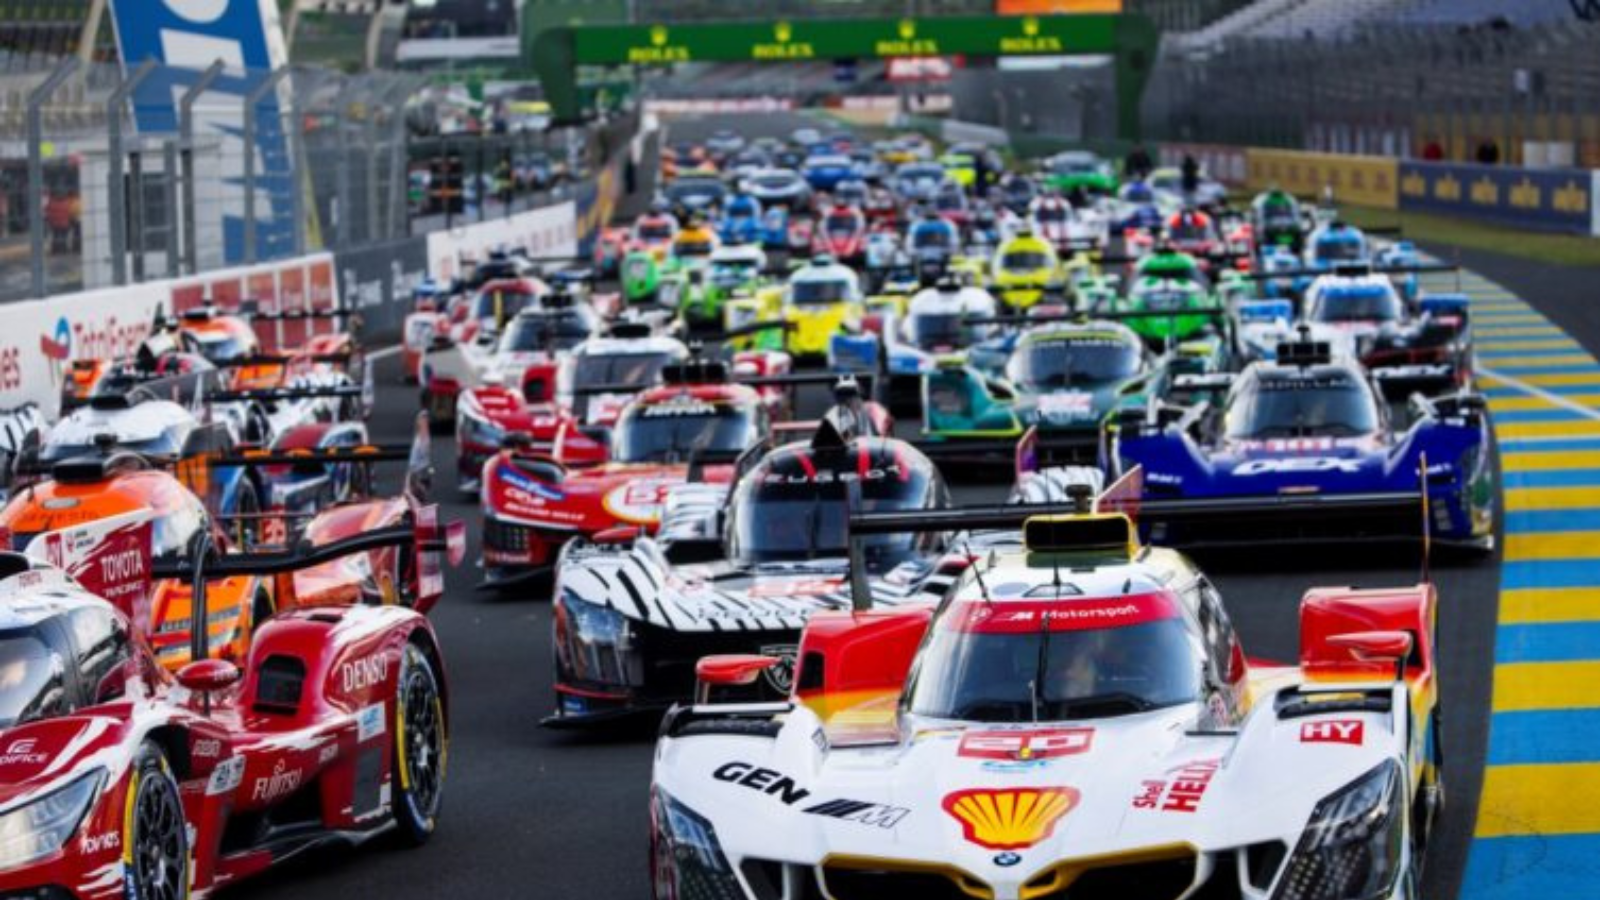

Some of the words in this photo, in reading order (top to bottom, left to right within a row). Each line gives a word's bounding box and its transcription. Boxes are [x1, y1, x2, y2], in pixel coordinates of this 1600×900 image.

[752, 44, 815, 58] ROLEX
[876, 41, 938, 55] ROLEX
[1000, 38, 1061, 51] ROLEX
[628, 48, 689, 61] ROLEX
[101, 548, 144, 584] TOYOTA
[1041, 604, 1139, 621] Motorsport
[343, 652, 388, 693] DENSO
[1303, 722, 1357, 740] HY
[252, 767, 303, 801] FUJITSU
[712, 761, 811, 806] GEN
